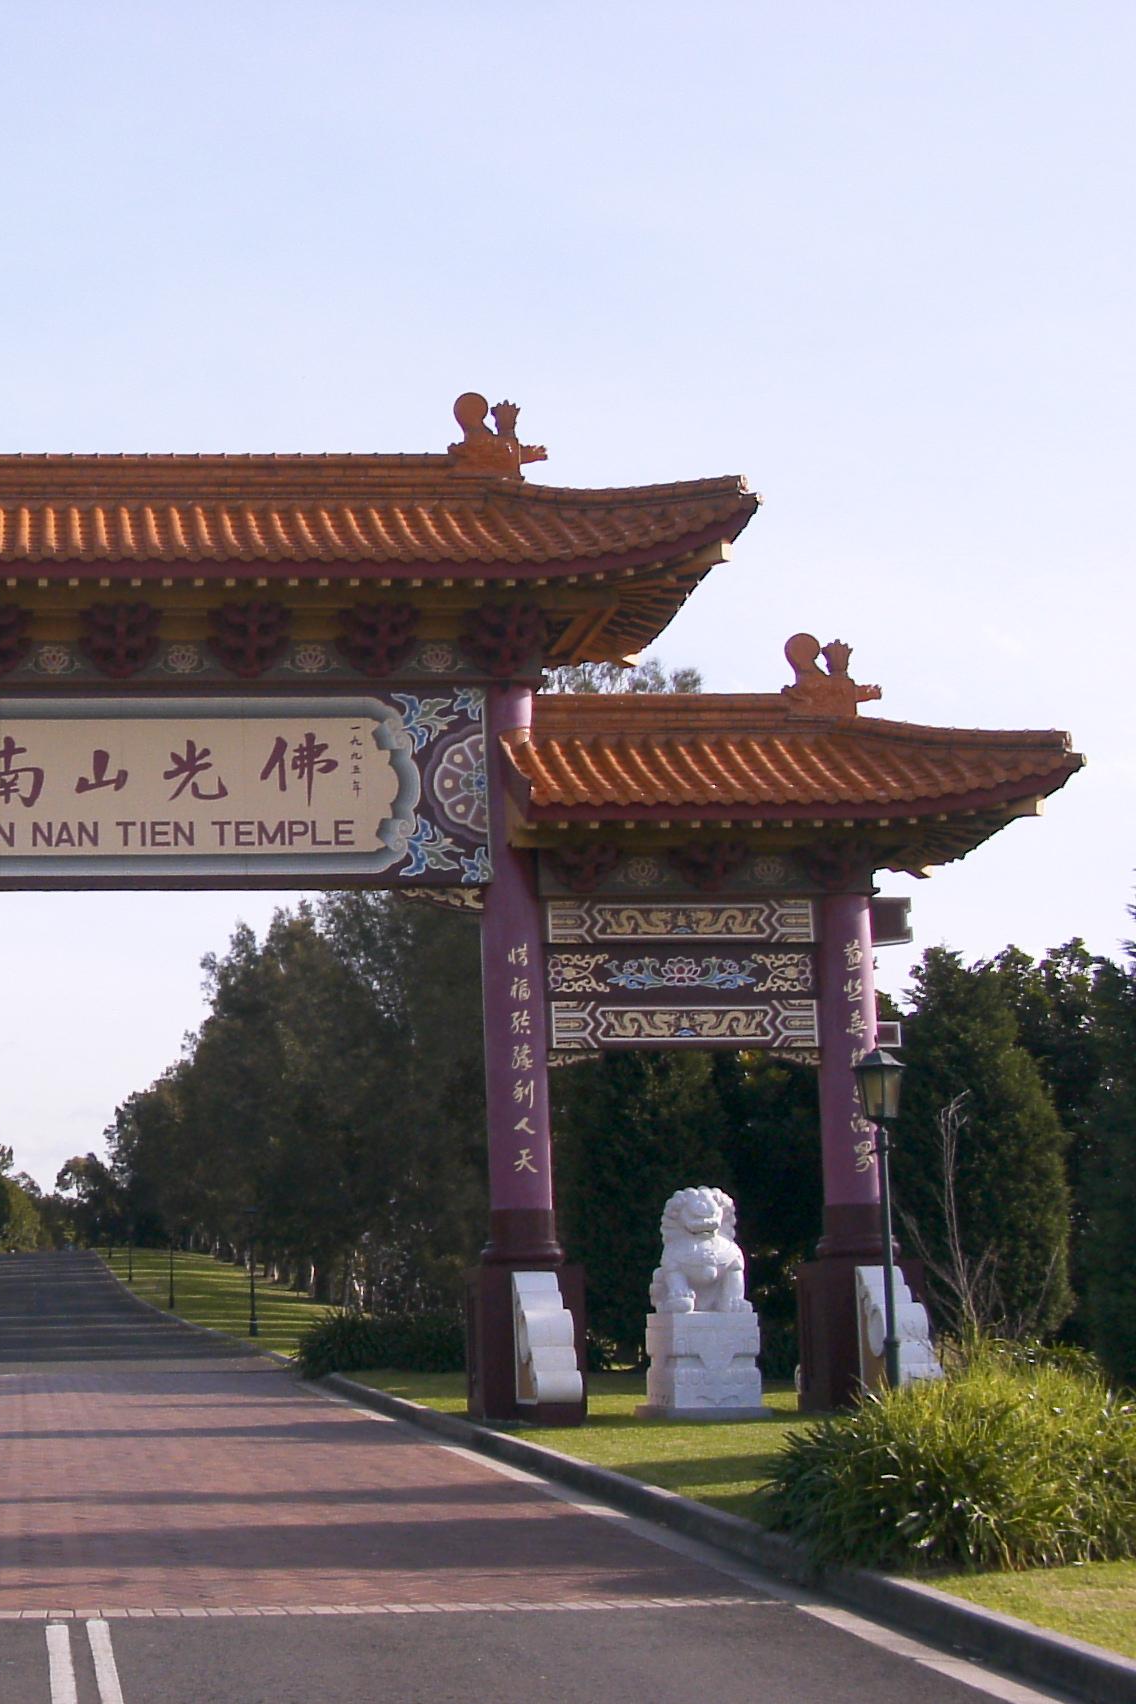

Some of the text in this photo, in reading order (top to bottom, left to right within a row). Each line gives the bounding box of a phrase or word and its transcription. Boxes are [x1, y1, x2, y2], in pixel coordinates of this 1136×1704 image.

[31, 821, 99, 847] NAN
[115, 820, 195, 847] TIEN
[211, 819, 355, 846] TEMPLE
